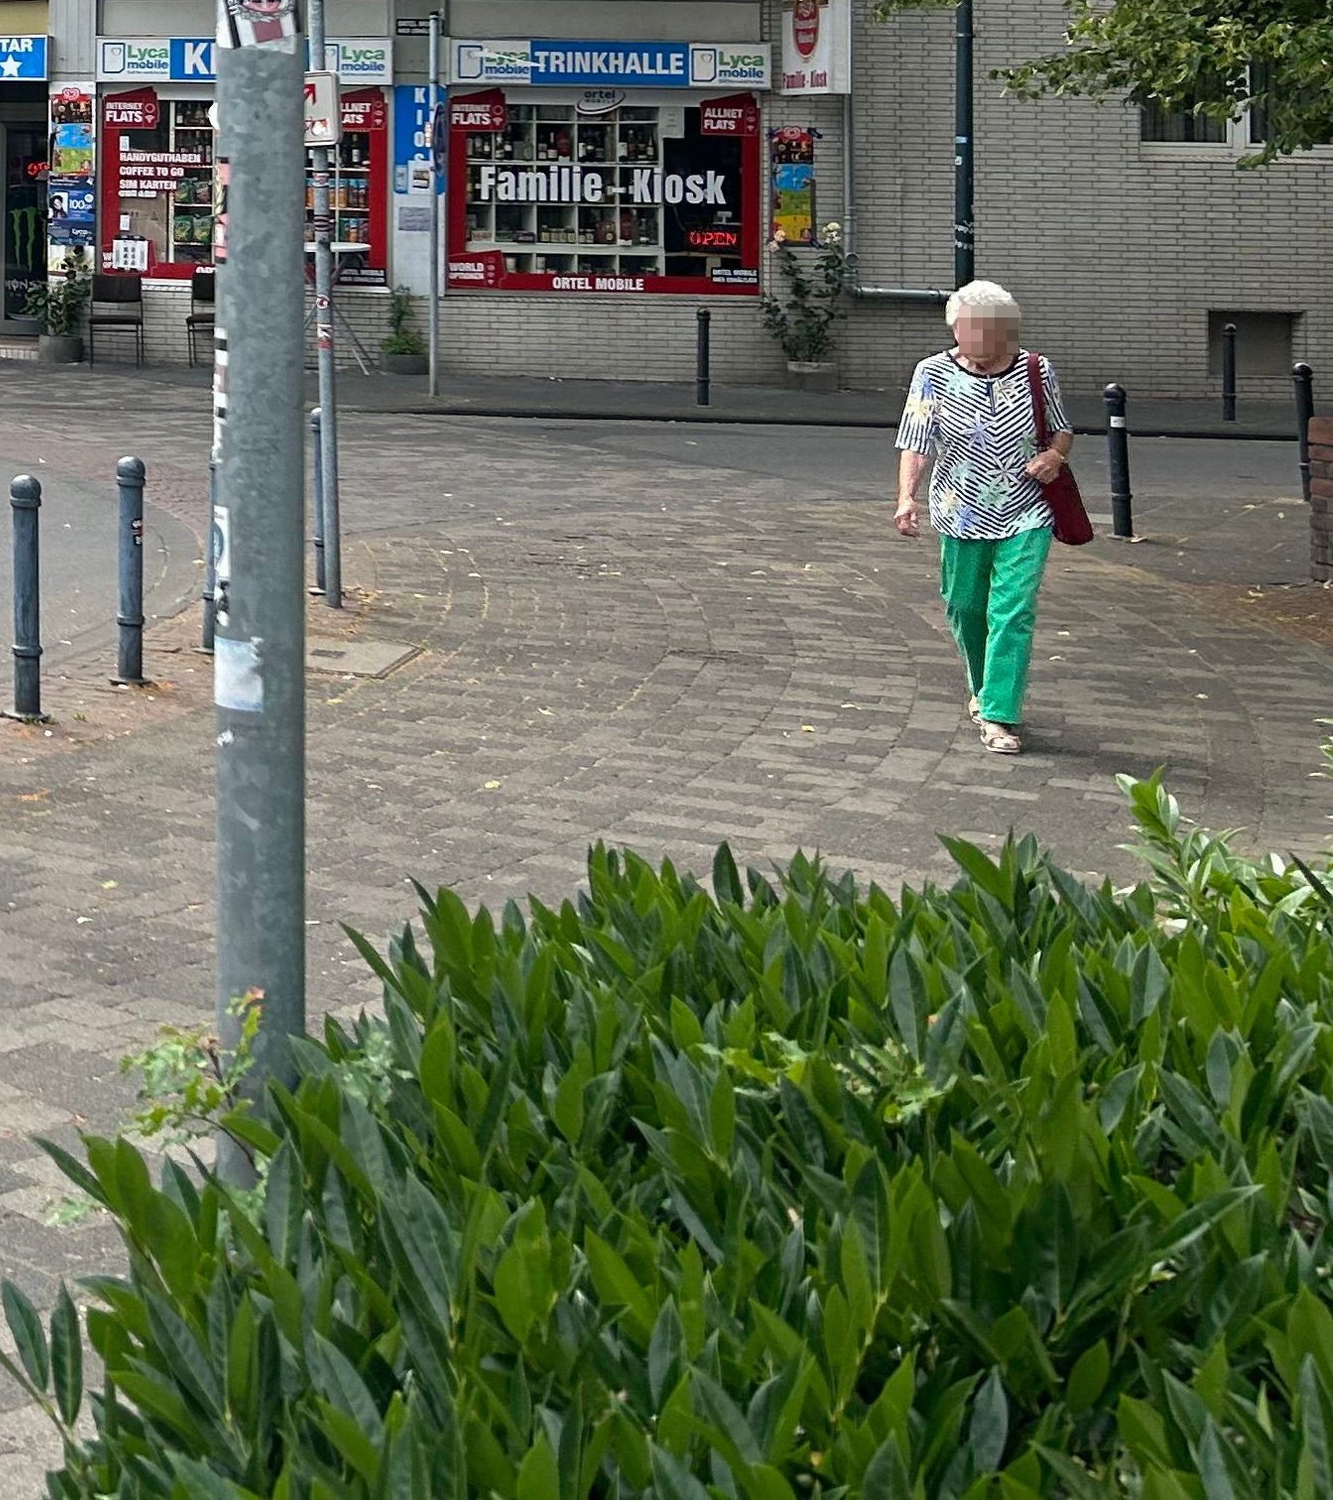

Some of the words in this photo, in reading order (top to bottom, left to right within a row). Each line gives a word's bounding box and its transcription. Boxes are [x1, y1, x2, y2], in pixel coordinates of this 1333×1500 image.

[127, 45, 169, 60] Lyca
[341, 46, 385, 61] Lyca
[718, 51, 764, 67] Lyca
[127, 60, 169, 70] mobile
[341, 61, 385, 72] mobile
[534, 51, 684, 75] TRINKHALLE
[718, 68, 764, 79] mobile
[105, 110, 143, 123] FLATS
[451, 112, 491, 125] FLATS
[704, 108, 744, 119] ALLNET
[704, 119, 736, 130] FLATS
[119, 166, 155, 176] COFFEE
[156, 167, 169, 176] TO
[170, 167, 185, 177] GO
[119, 179, 138, 189] SIM
[139, 180, 177, 190] KARTEN
[479, 165, 604, 202] Familie
[632, 166, 727, 205] Kiosk
[689, 231, 737, 246] OPEN
[448, 262, 485, 272] WORLD
[552, 277, 592, 290] ORTEL
[595, 278, 645, 291] MOBILE
